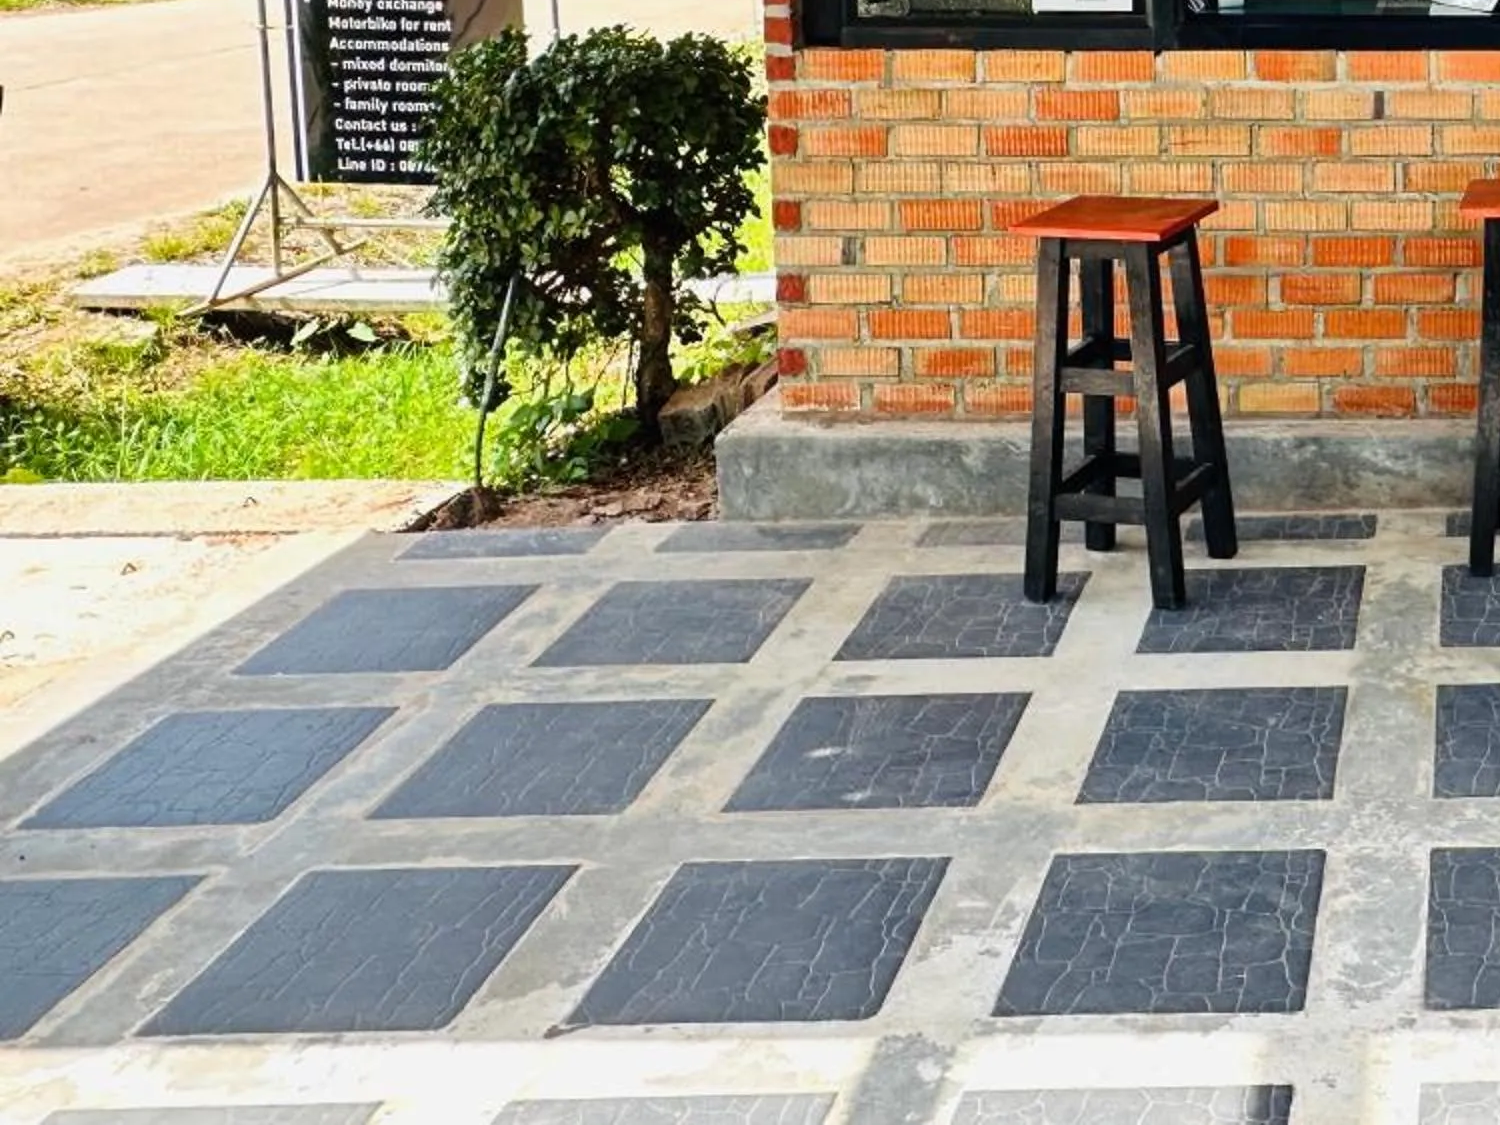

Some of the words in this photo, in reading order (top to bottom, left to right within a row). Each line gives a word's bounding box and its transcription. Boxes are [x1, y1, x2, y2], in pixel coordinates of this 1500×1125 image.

[328, 16, 397, 31] Motorbike
[400, 17, 421, 31] for
[423, 19, 452, 32] rent
[329, 36, 450, 52] Accommodations
[342, 56, 386, 72] mixed
[343, 76, 392, 93] private
[344, 96, 389, 115] family
[335, 118, 387, 132] Contact
[390, 121, 408, 132] us
[337, 156, 367, 171] Line
[371, 158, 386, 172] ID
